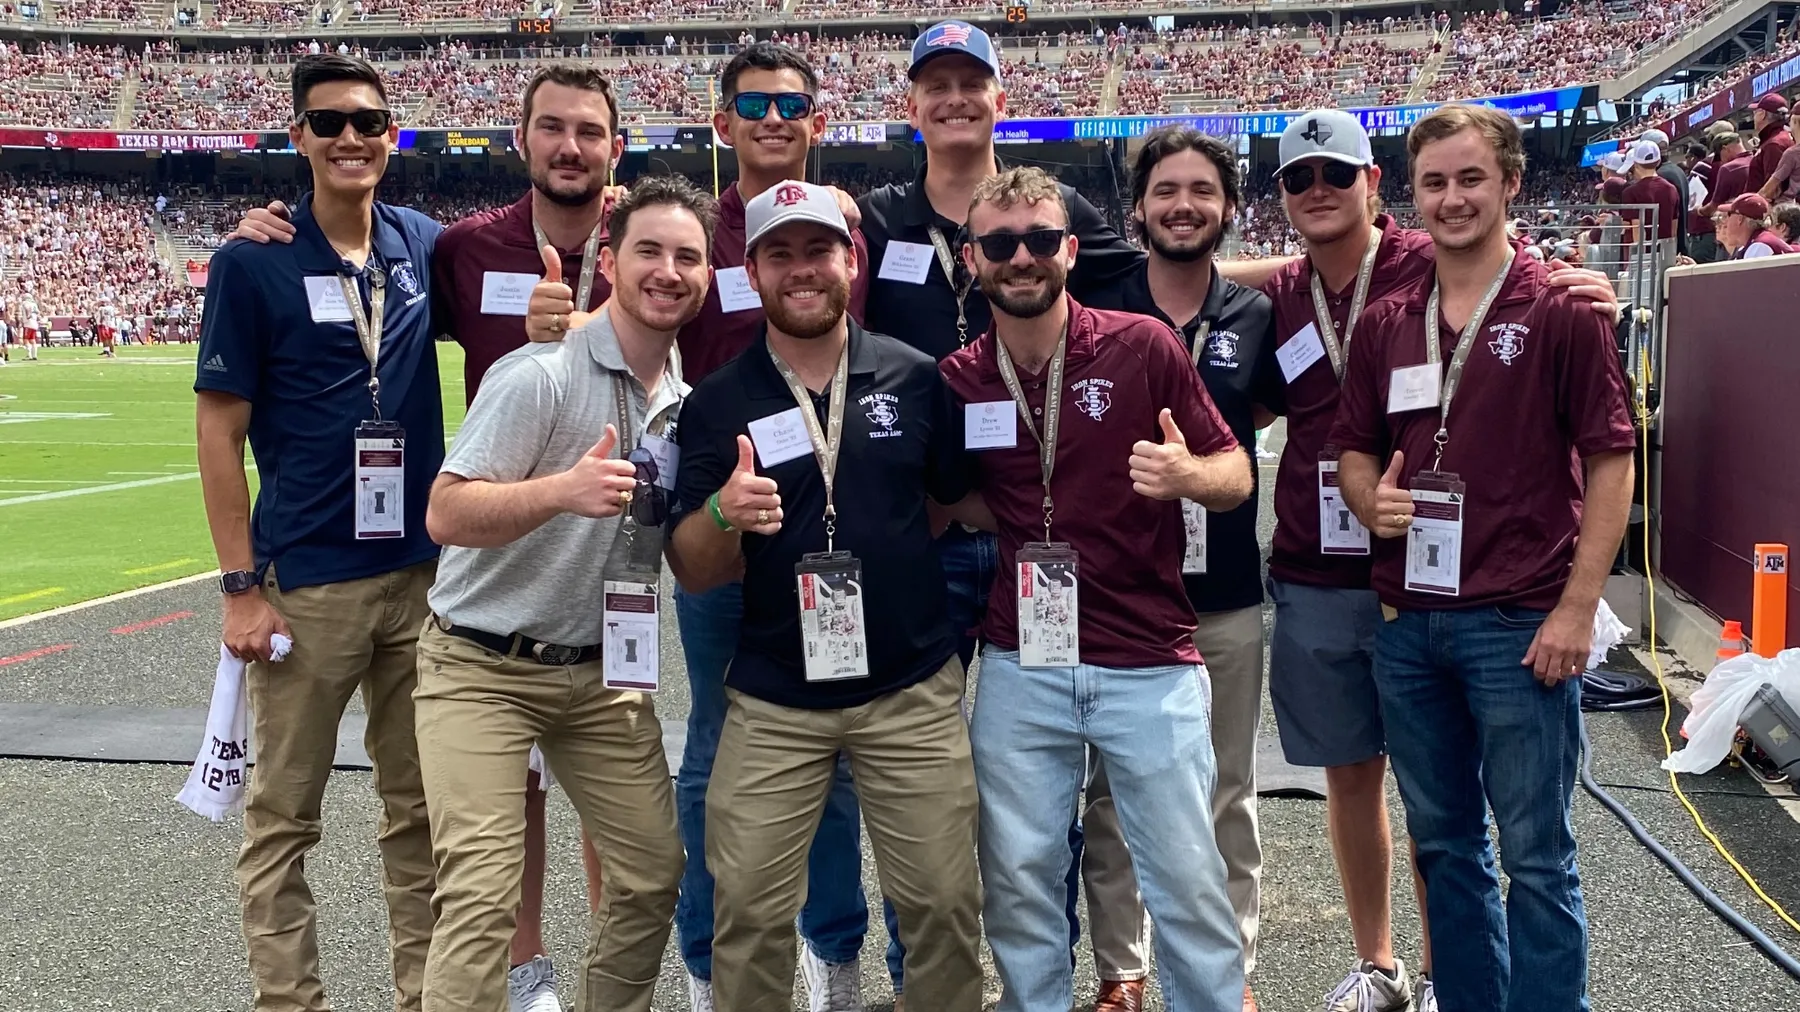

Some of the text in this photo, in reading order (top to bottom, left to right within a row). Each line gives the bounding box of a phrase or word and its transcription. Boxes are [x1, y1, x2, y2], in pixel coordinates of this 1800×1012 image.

[1007, 7, 1026, 23] 25
[1527, 102, 1547, 113] Health
[838, 125, 857, 141] 34
[1005, 129, 1029, 139] Health
[1074, 121, 1123, 136] OFFICIAL
[1203, 117, 1259, 134] PROVIDER
[1265, 116, 1278, 131] OF
[116, 133, 246, 148] TEXAS A&M FOOTBALL
[447, 137, 490, 146] SCOREBOARD
[1052, 371, 1060, 388] Texas
[1070, 378, 1114, 391] IRON SPIKES
[1050, 389, 1058, 407] A&M
[1046, 408, 1057, 440] University
[1045, 442, 1053, 464] System
[211, 735, 248, 761] TEAS
